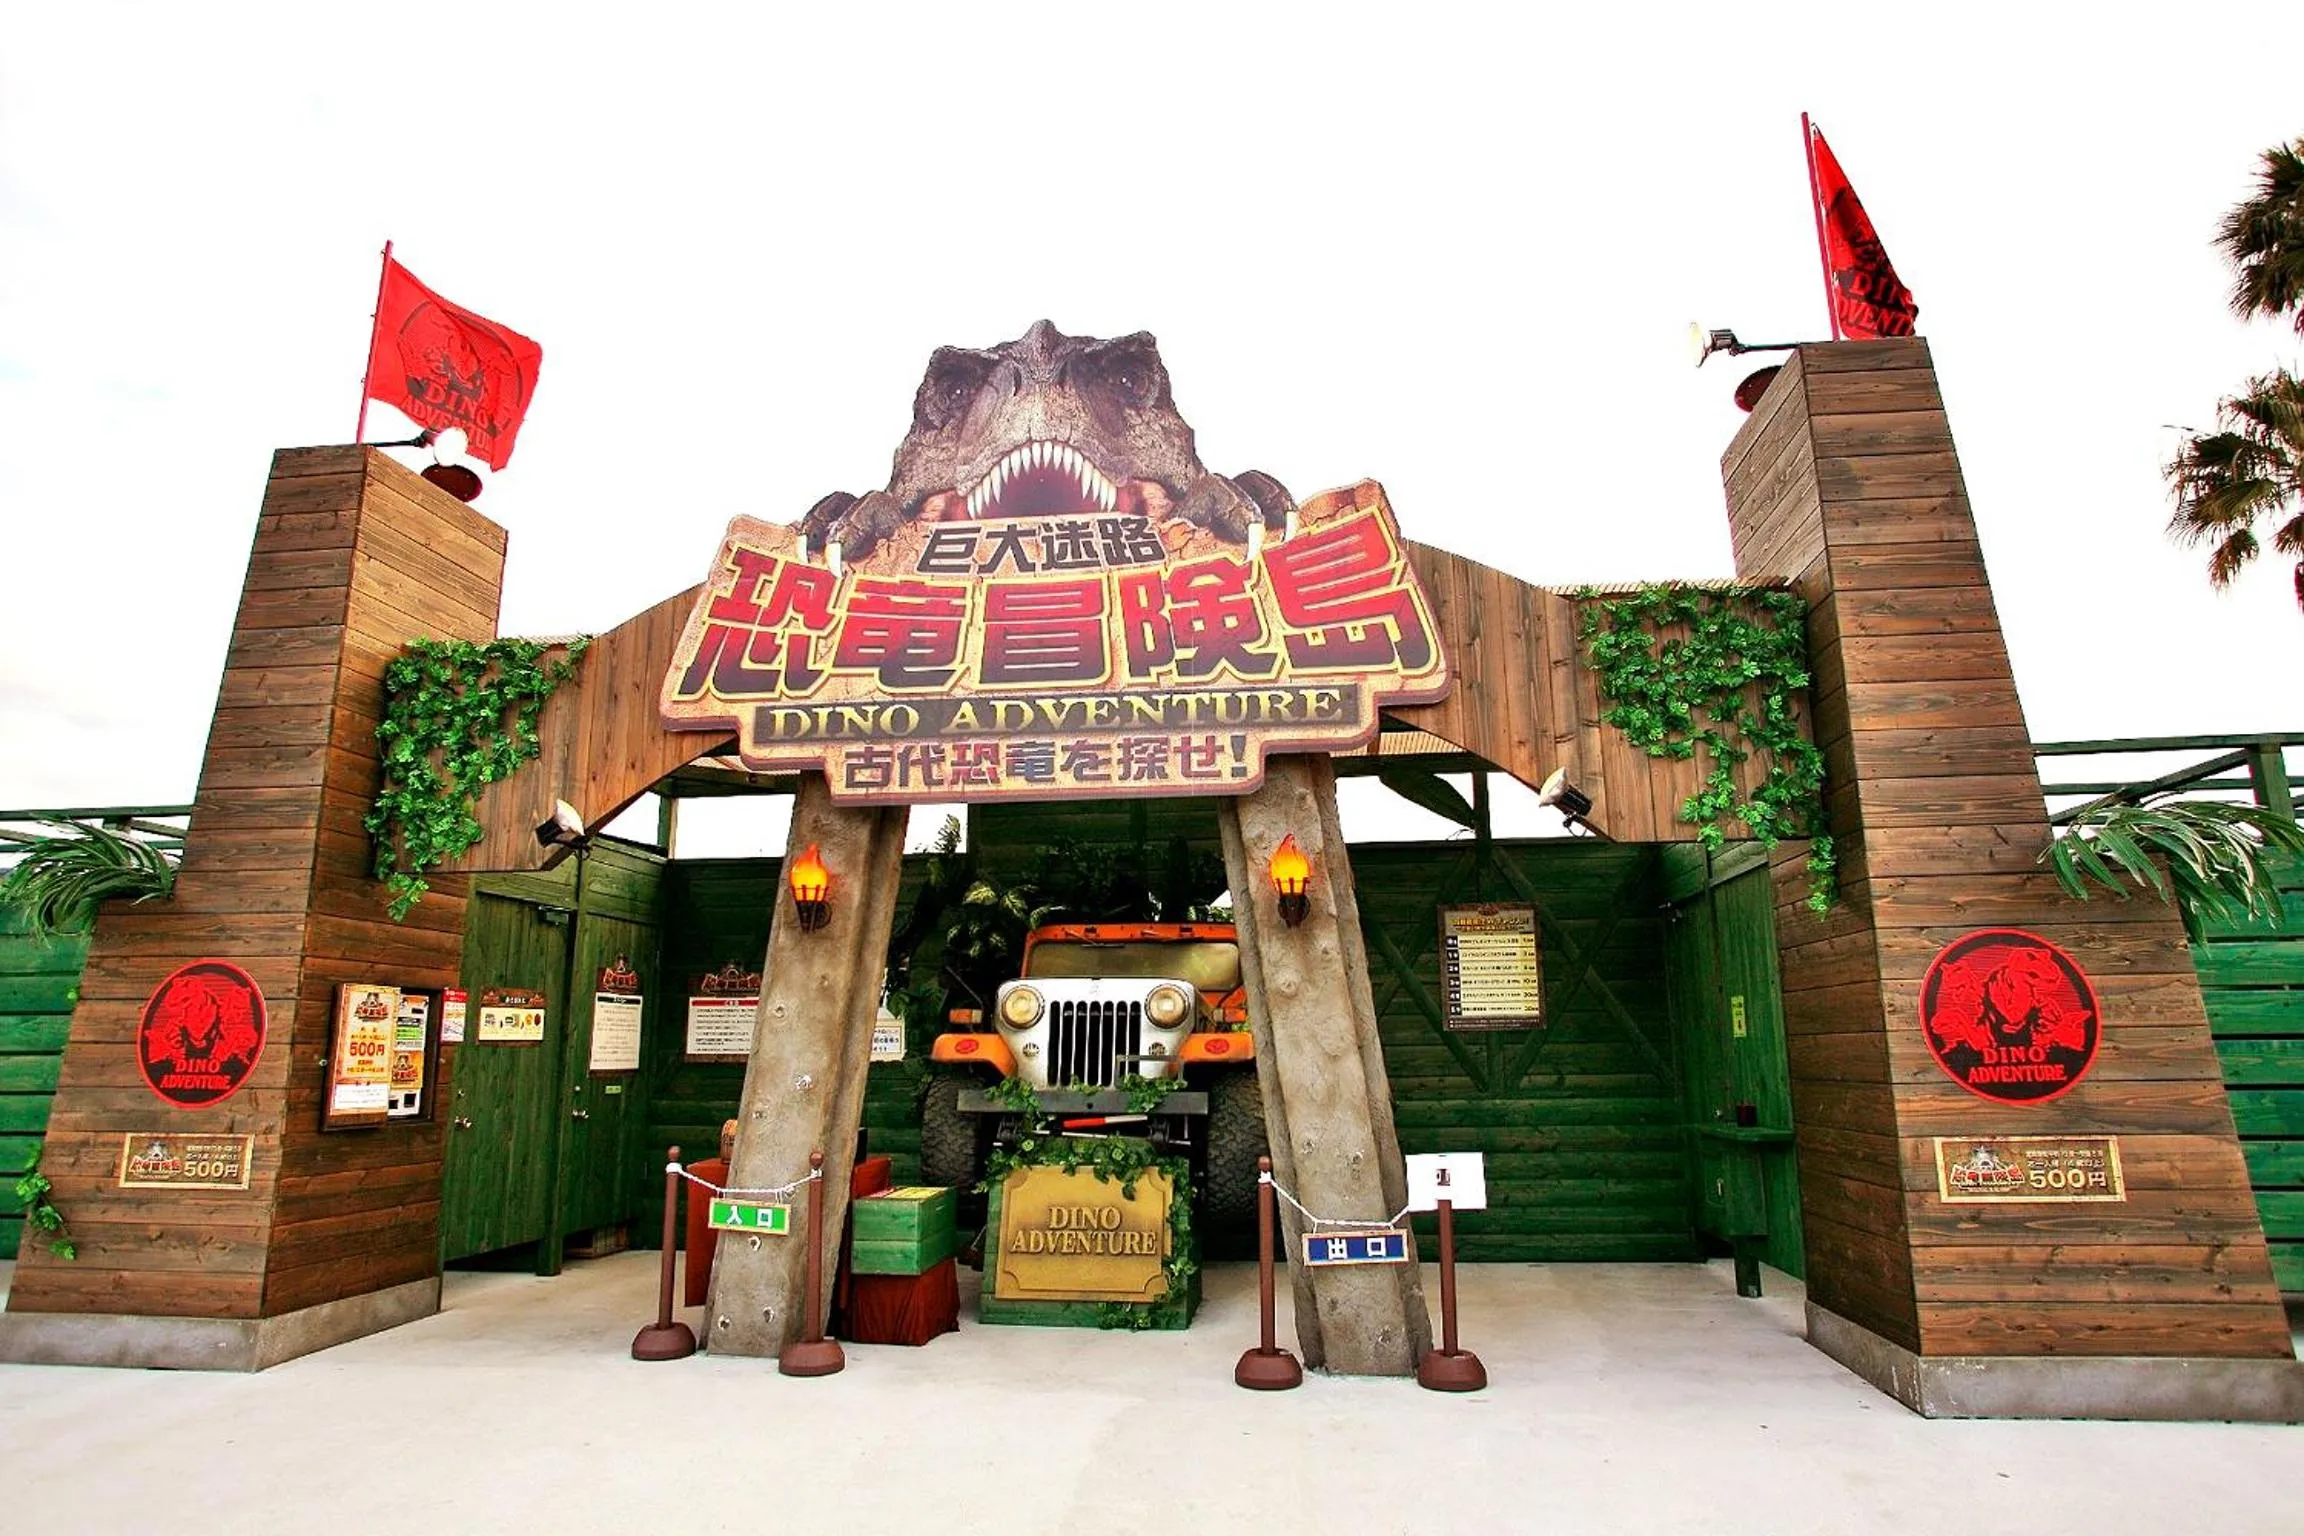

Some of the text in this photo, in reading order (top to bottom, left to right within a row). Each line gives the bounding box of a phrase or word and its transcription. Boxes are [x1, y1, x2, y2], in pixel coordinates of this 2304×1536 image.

[916, 517, 1167, 576] 巨大迷路
[677, 511, 1435, 697] 恐竜冒険島
[768, 689, 1344, 740] DINO ADVENTURE
[844, 735, 1248, 790] 古代恐竜を探せ!
[175, 1059, 221, 1074] DINO
[1981, 1046, 2050, 1065] DINO
[160, 1074, 232, 1090] ADVENTURE
[1968, 1064, 2068, 1084] ADVENTURE
[184, 1160, 240, 1178] 500円
[2029, 1168, 2108, 1189] 500円
[726, 1205, 773, 1229] 入口
[1048, 1206, 1122, 1231] DINO
[1009, 1229, 1157, 1255] ADVENTURE
[1326, 1236, 1387, 1260] 出口
